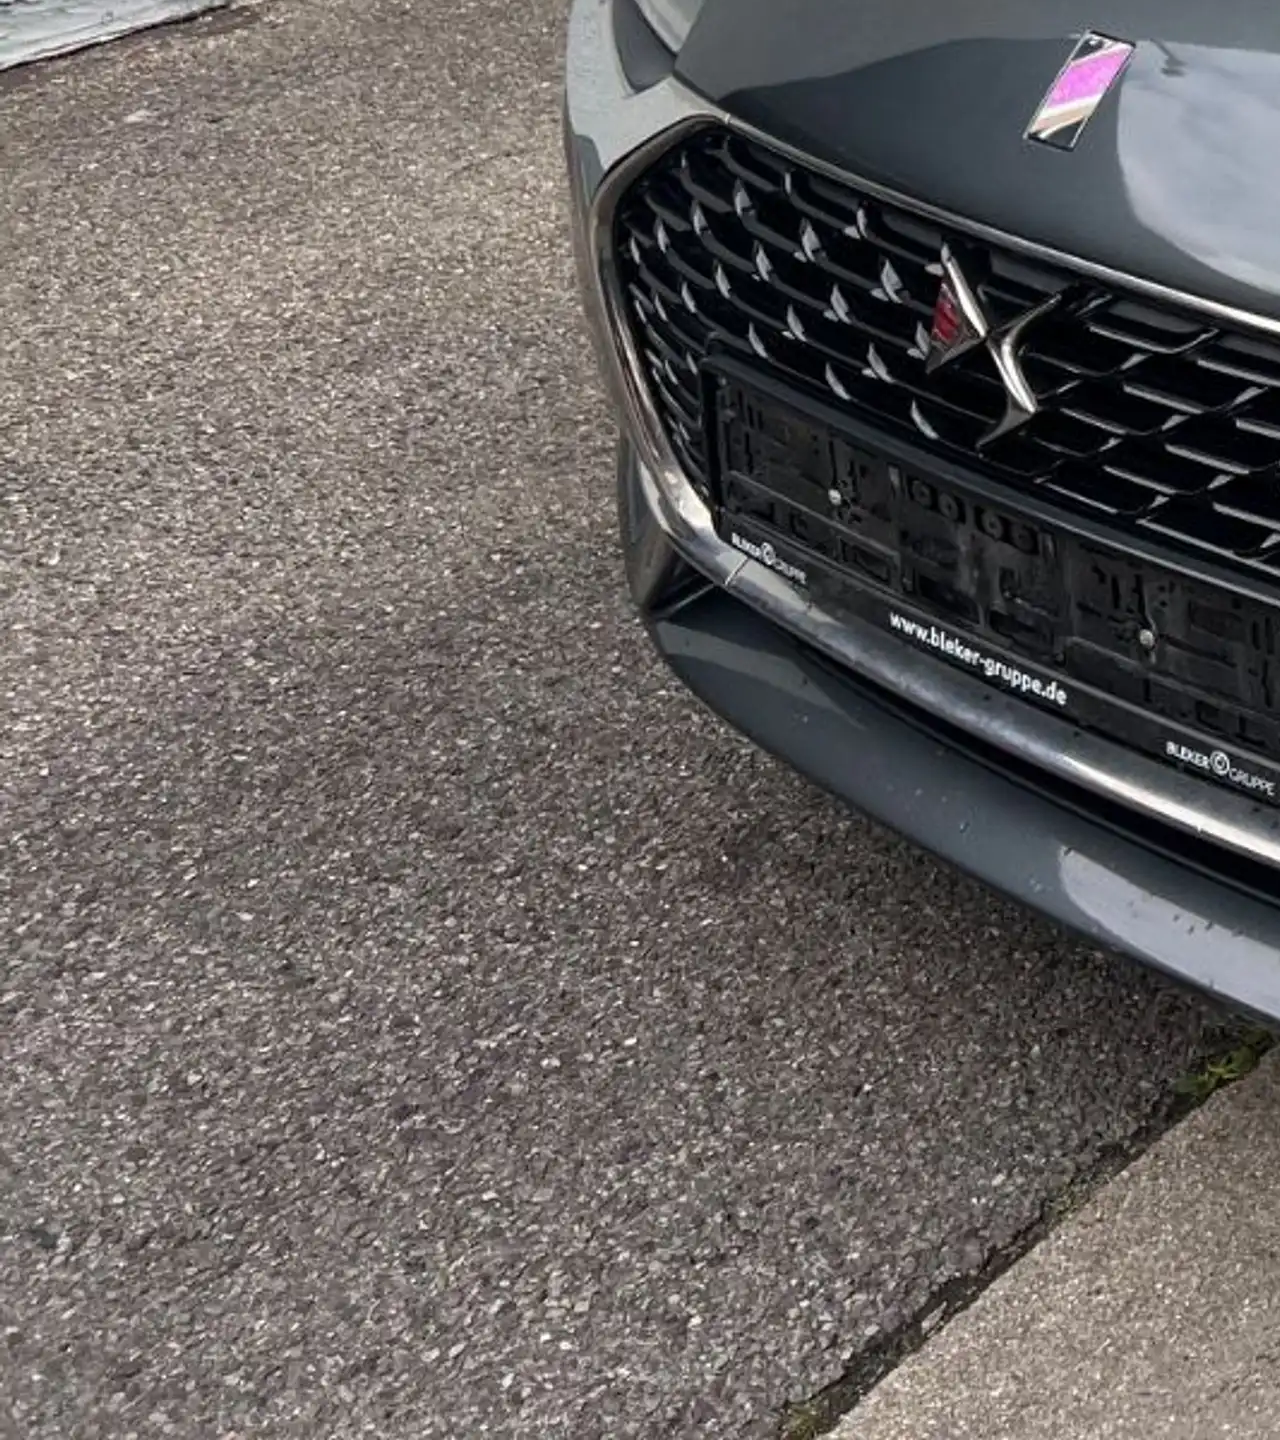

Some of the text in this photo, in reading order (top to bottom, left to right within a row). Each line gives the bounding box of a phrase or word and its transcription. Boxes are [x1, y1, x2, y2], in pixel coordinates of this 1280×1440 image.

[889, 611, 1068, 706] www.bleker-gruppe.de
[1166, 741, 1277, 797] BLEKER GRUPPE
